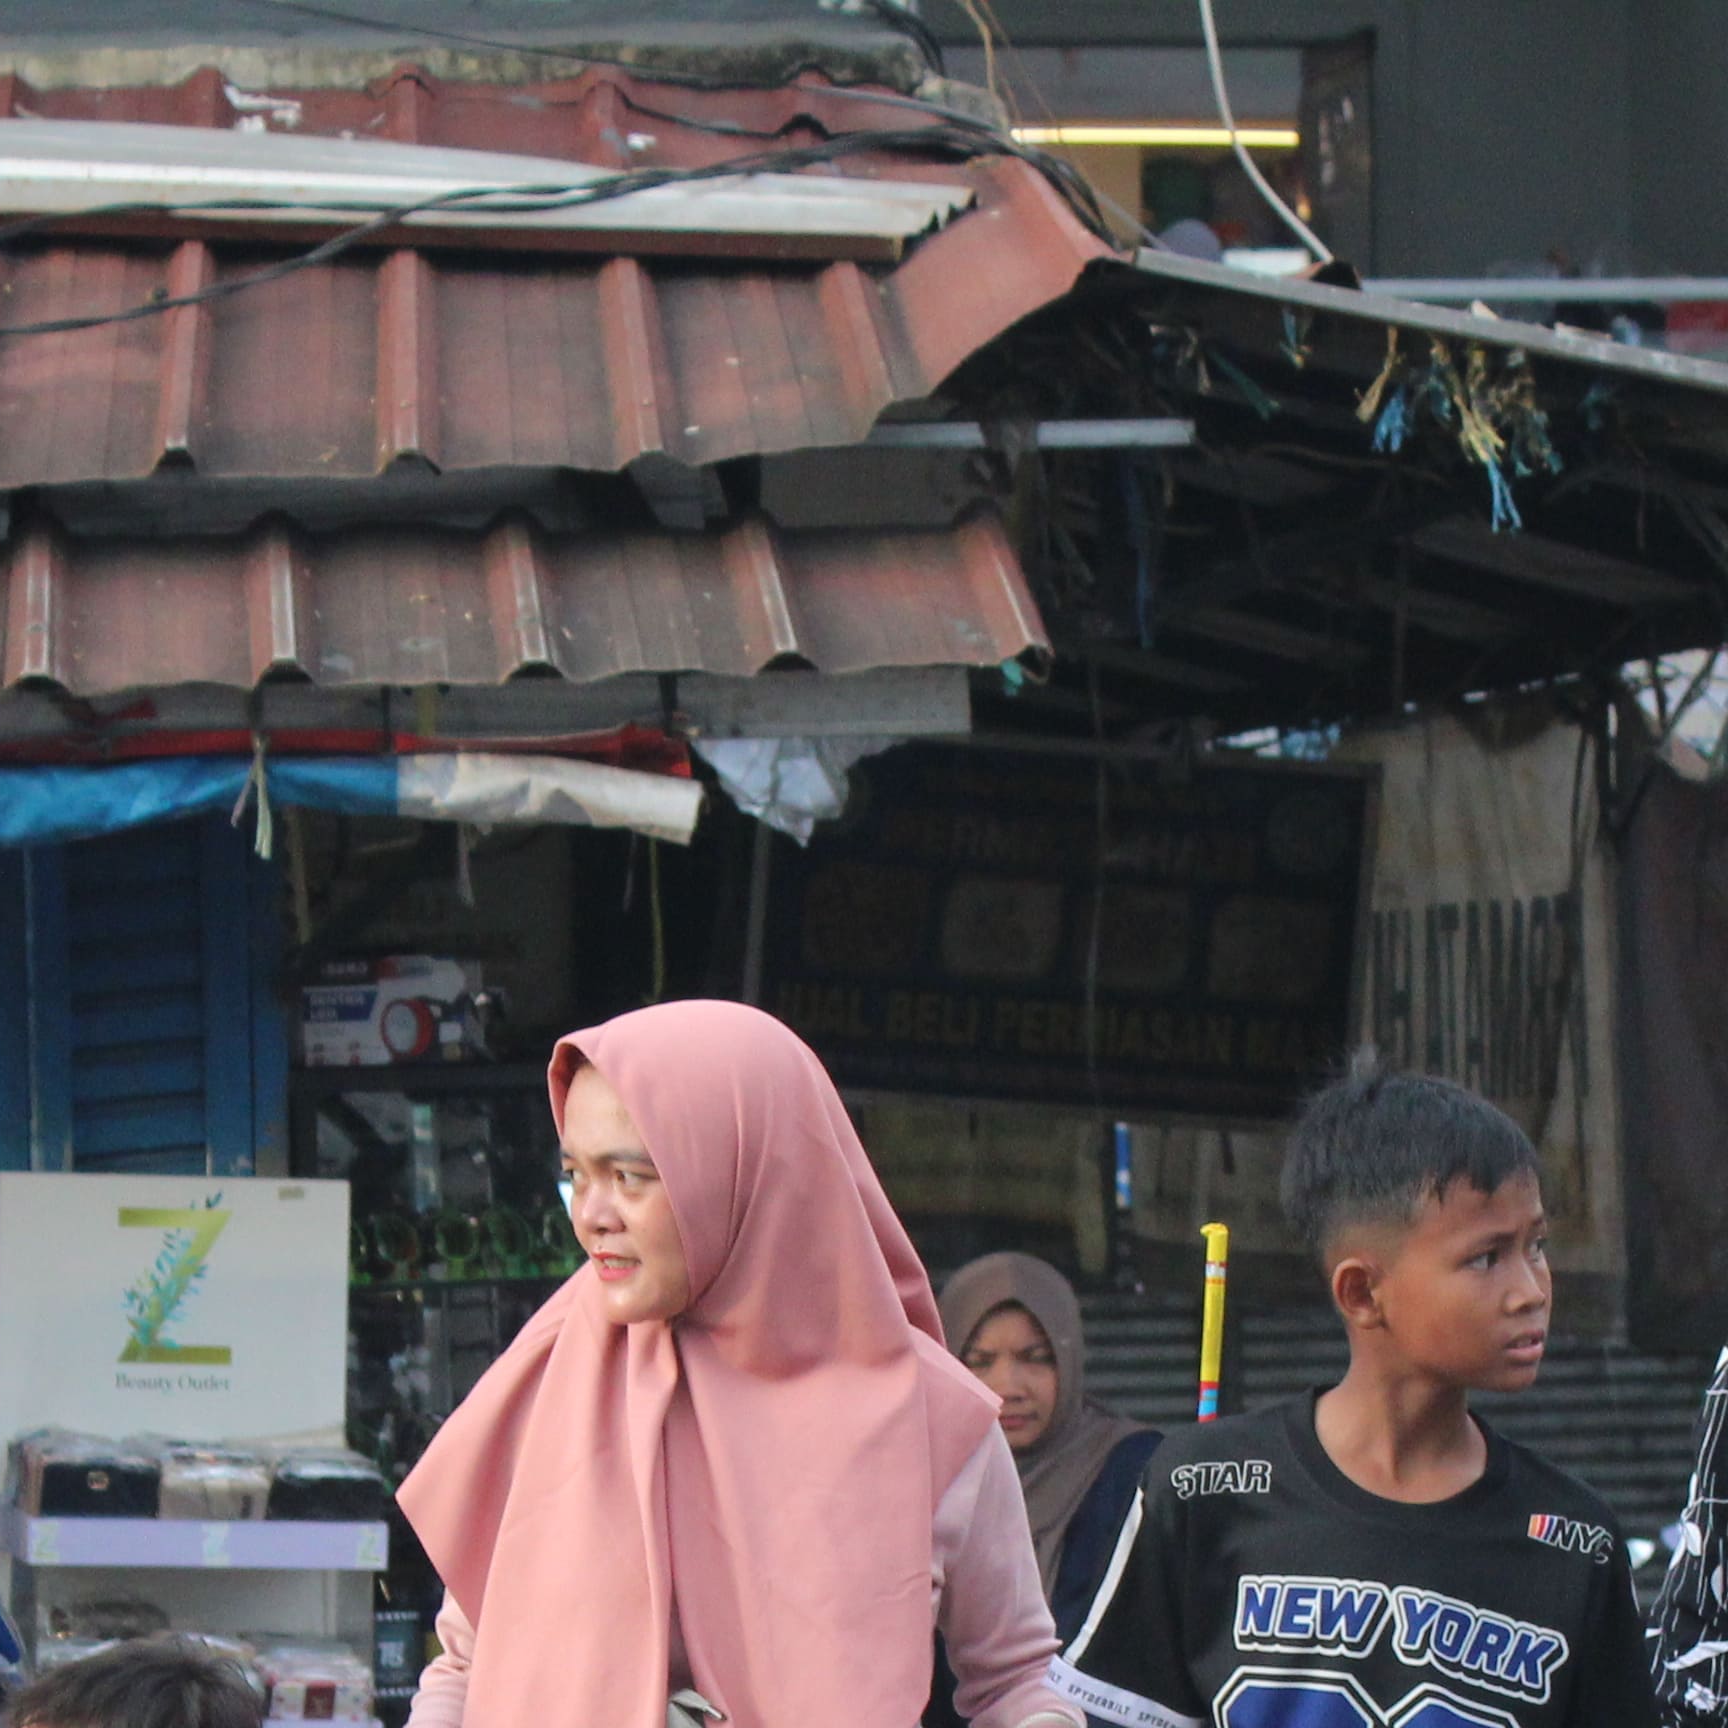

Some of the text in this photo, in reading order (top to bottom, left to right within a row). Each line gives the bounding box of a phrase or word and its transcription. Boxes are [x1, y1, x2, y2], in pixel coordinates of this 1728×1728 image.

[115, 1373, 231, 1392] Beauty Outlet
[1171, 1460, 1272, 1499] STAR
[1234, 1575, 1570, 1704] NEW YORK
[1068, 1683, 1131, 1716] SPYDERBILT
